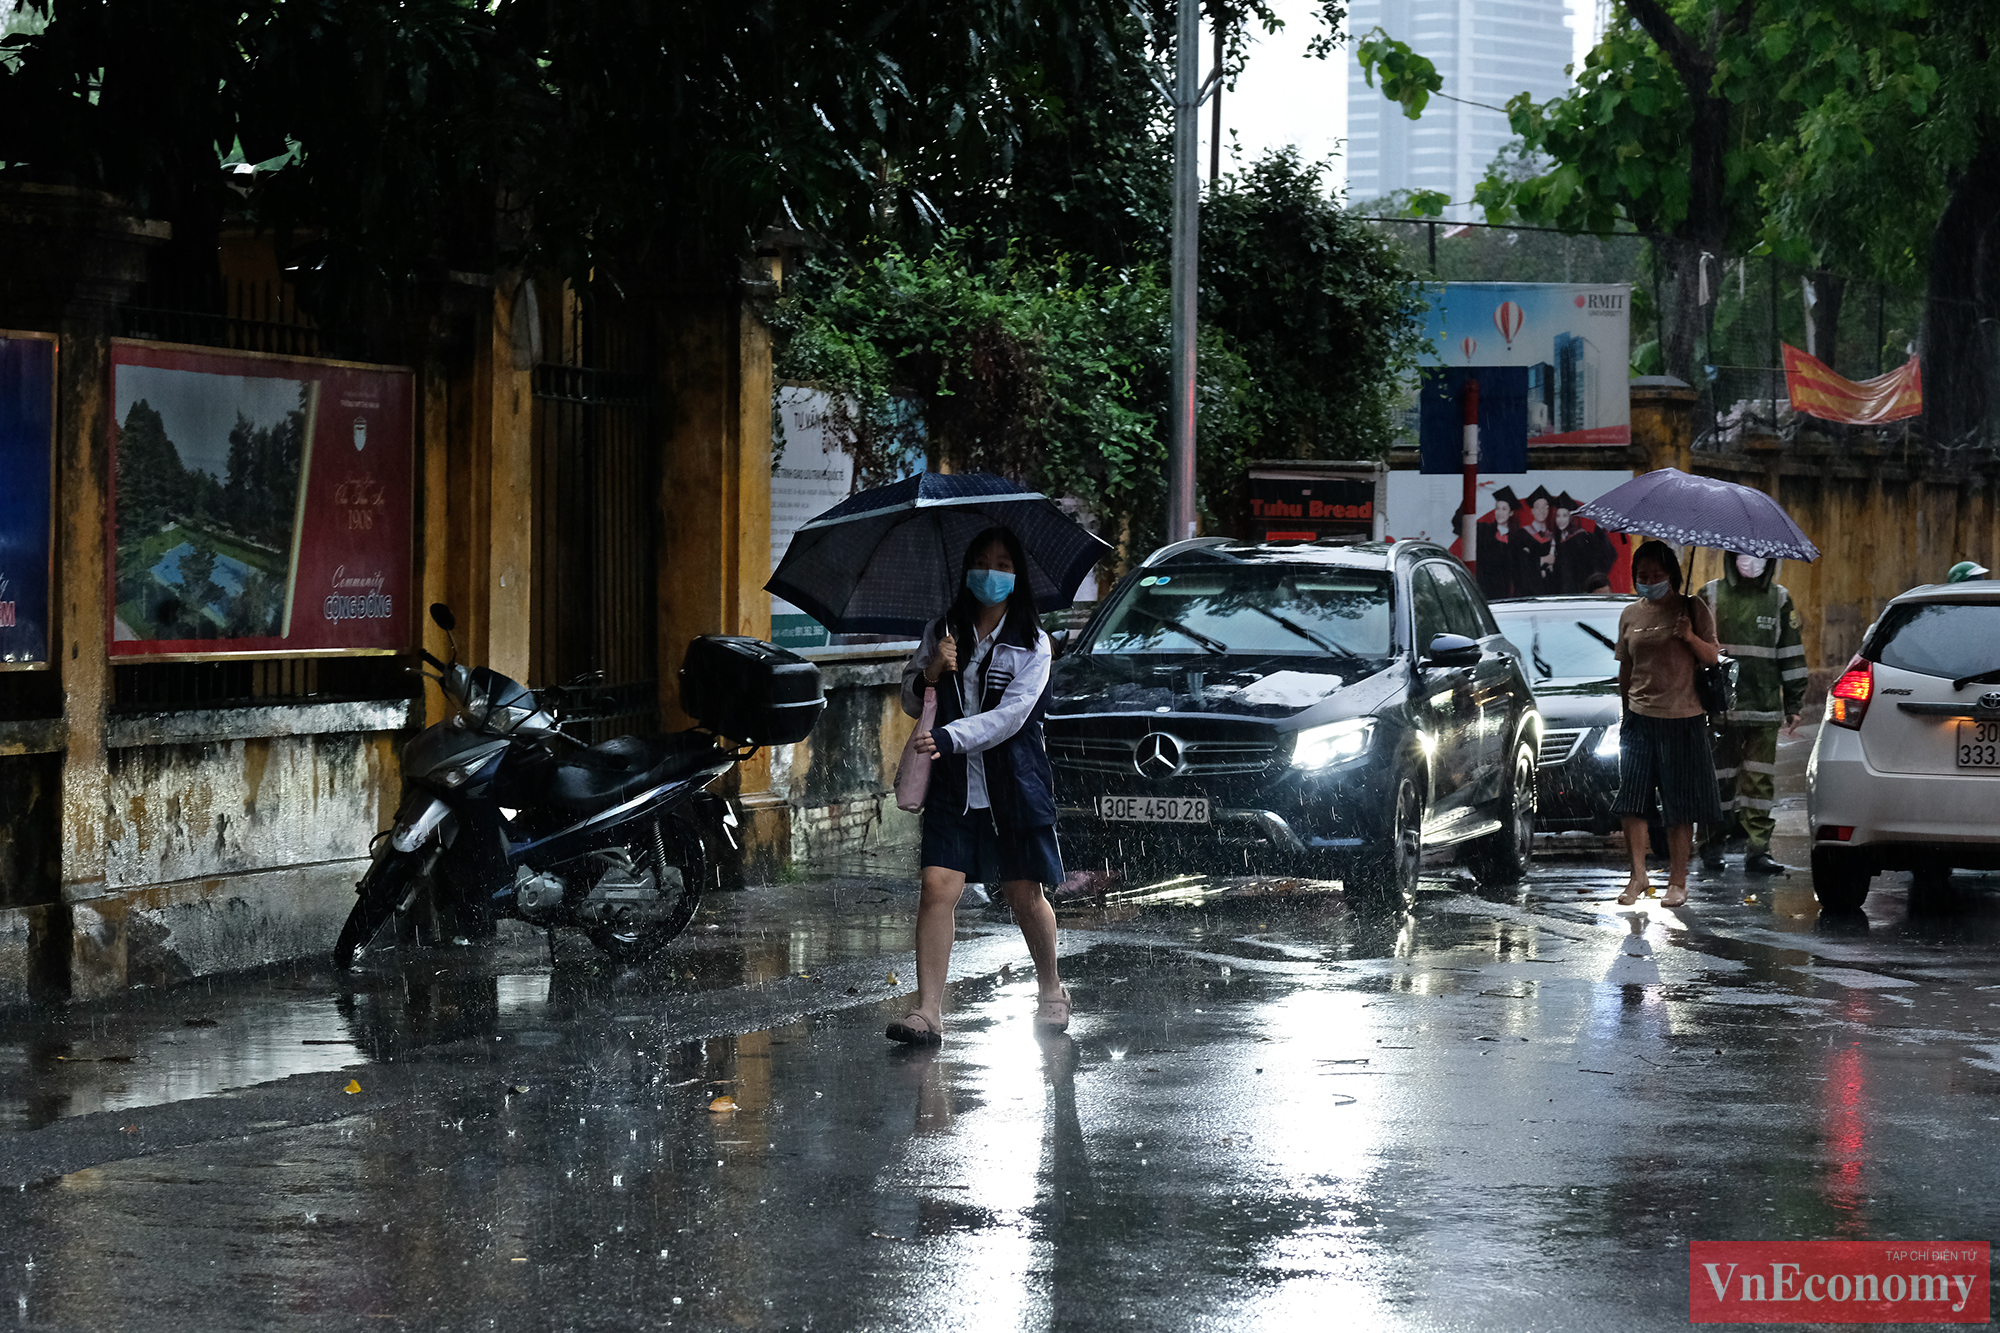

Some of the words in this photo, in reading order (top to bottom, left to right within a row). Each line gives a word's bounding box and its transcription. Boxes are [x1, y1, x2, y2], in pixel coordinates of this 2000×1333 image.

[1588, 293, 1624, 309] RMIT
[1250, 498, 1303, 518] Tuhu
[1309, 500, 1373, 519] Bread
[348, 509, 373, 530] 1908
[331, 564, 386, 597] Community
